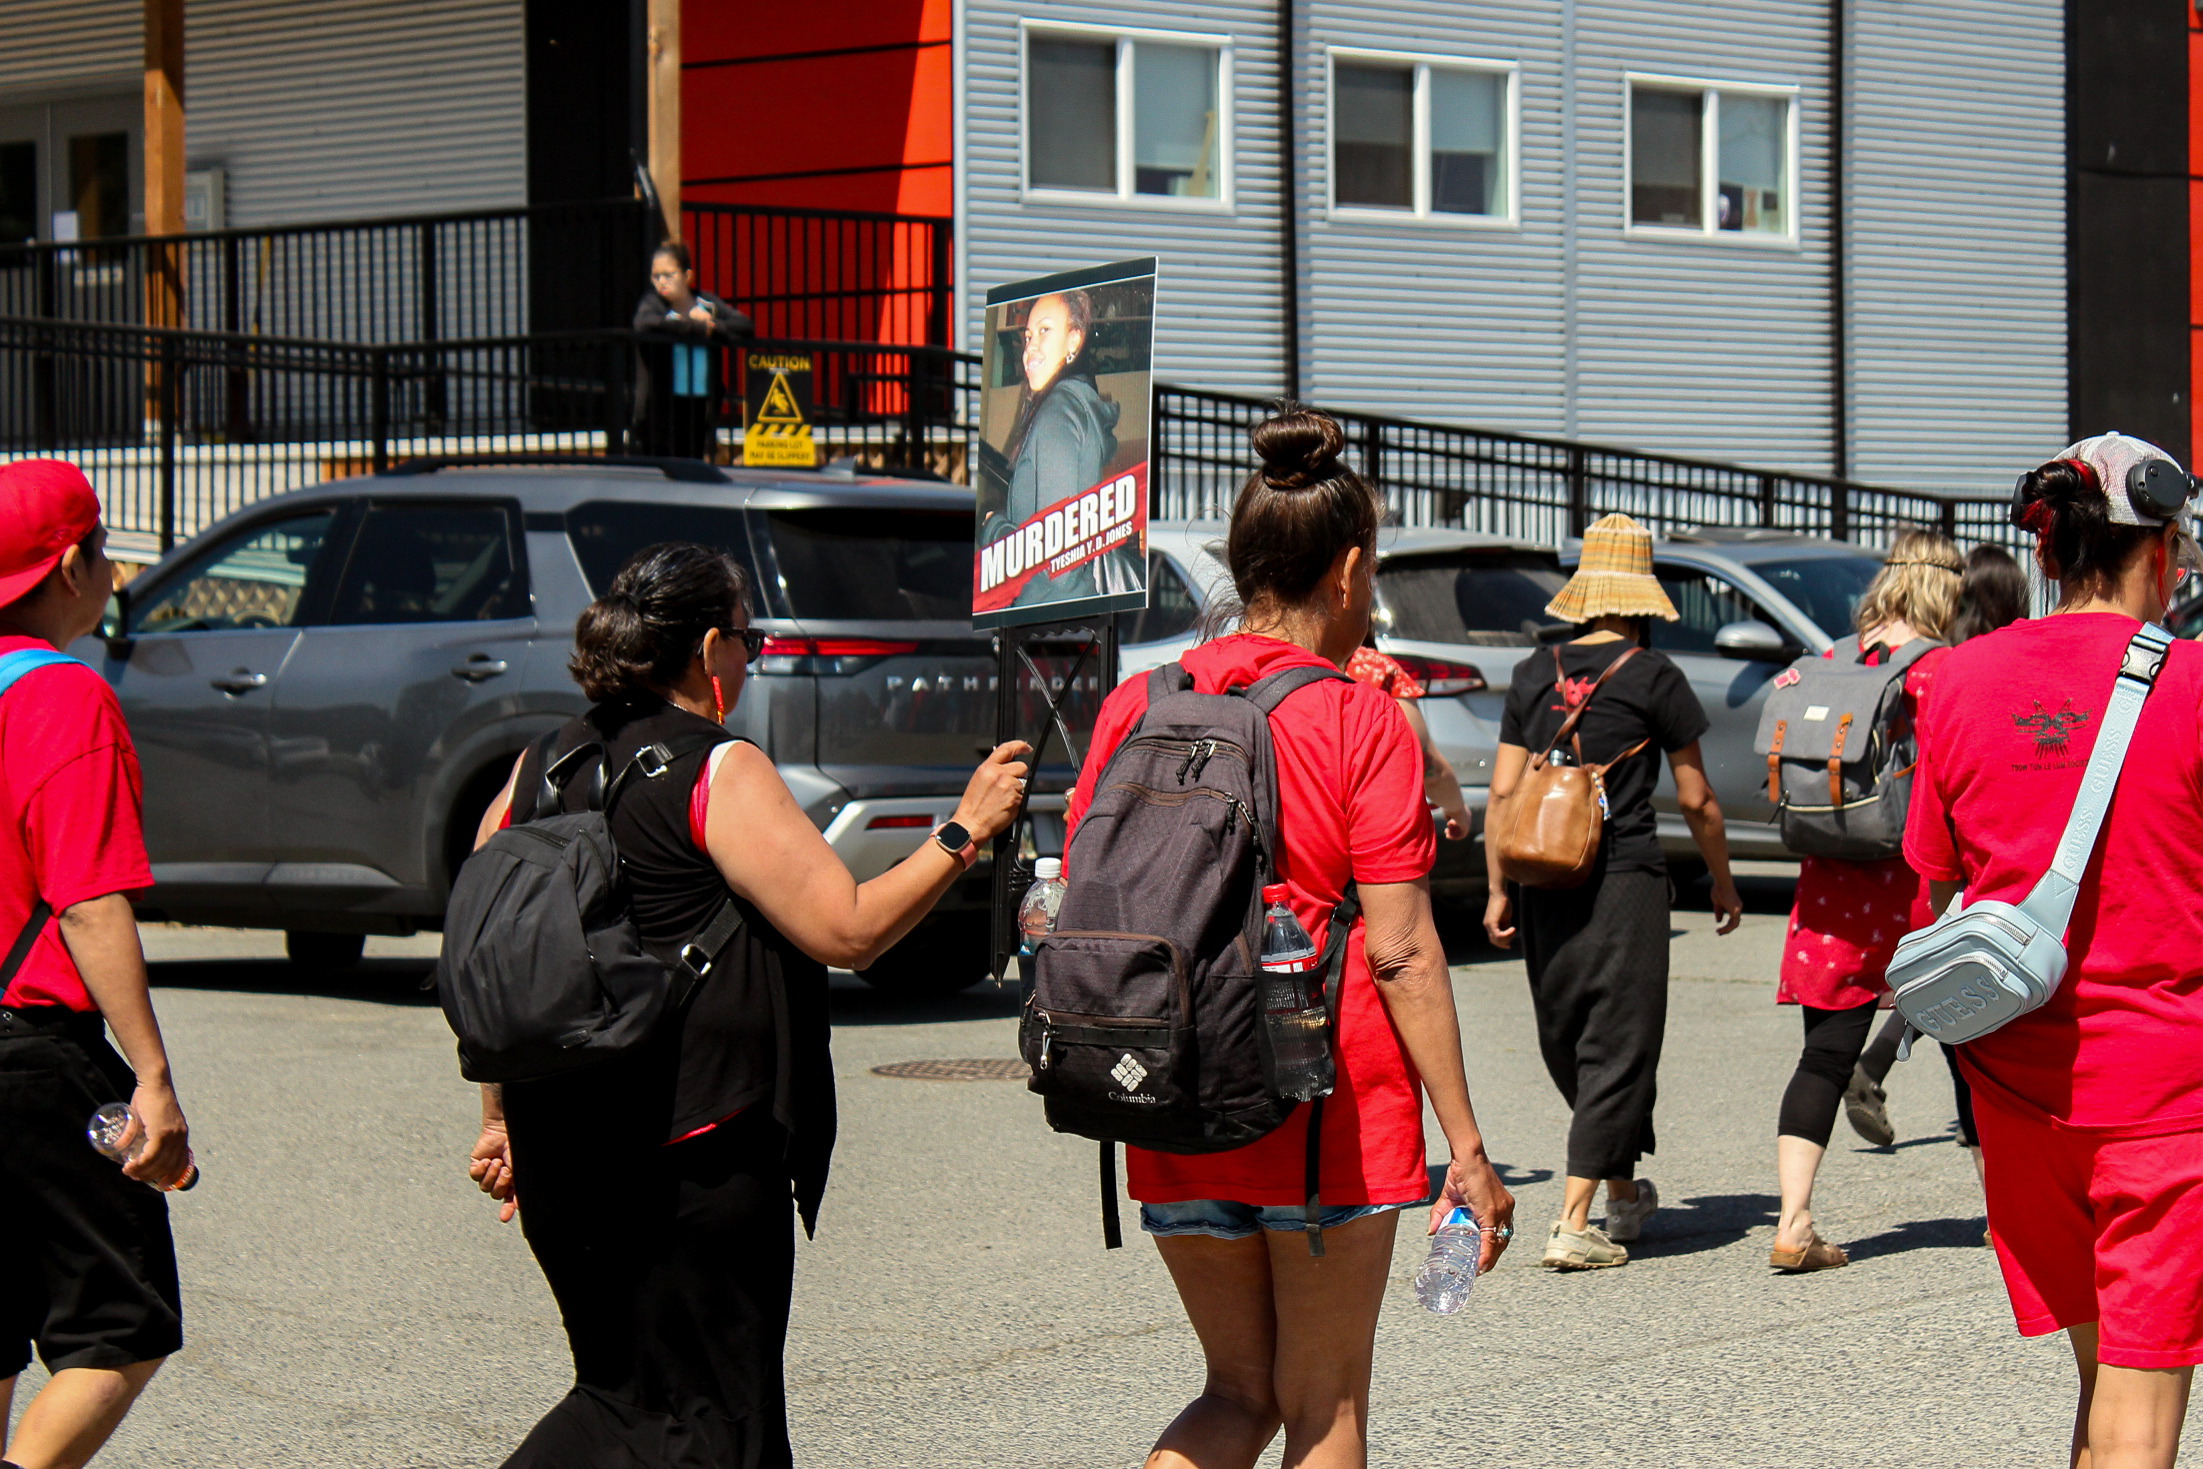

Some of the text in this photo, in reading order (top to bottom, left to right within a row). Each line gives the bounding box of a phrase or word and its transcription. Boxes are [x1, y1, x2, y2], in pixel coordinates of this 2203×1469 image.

[749, 354, 811, 371] CAUTION
[980, 474, 1136, 593] MURDERED
[1051, 544, 1086, 573] TYESHIA
[1106, 520, 1133, 546] JONES
[2068, 759, 2090, 768] SOCIET
[2090, 728, 2121, 793] GUESS
[2063, 806, 2094, 871] GUESS
[1916, 975, 2000, 1032] GUESS
[1108, 1091, 1156, 1104] Columbia
